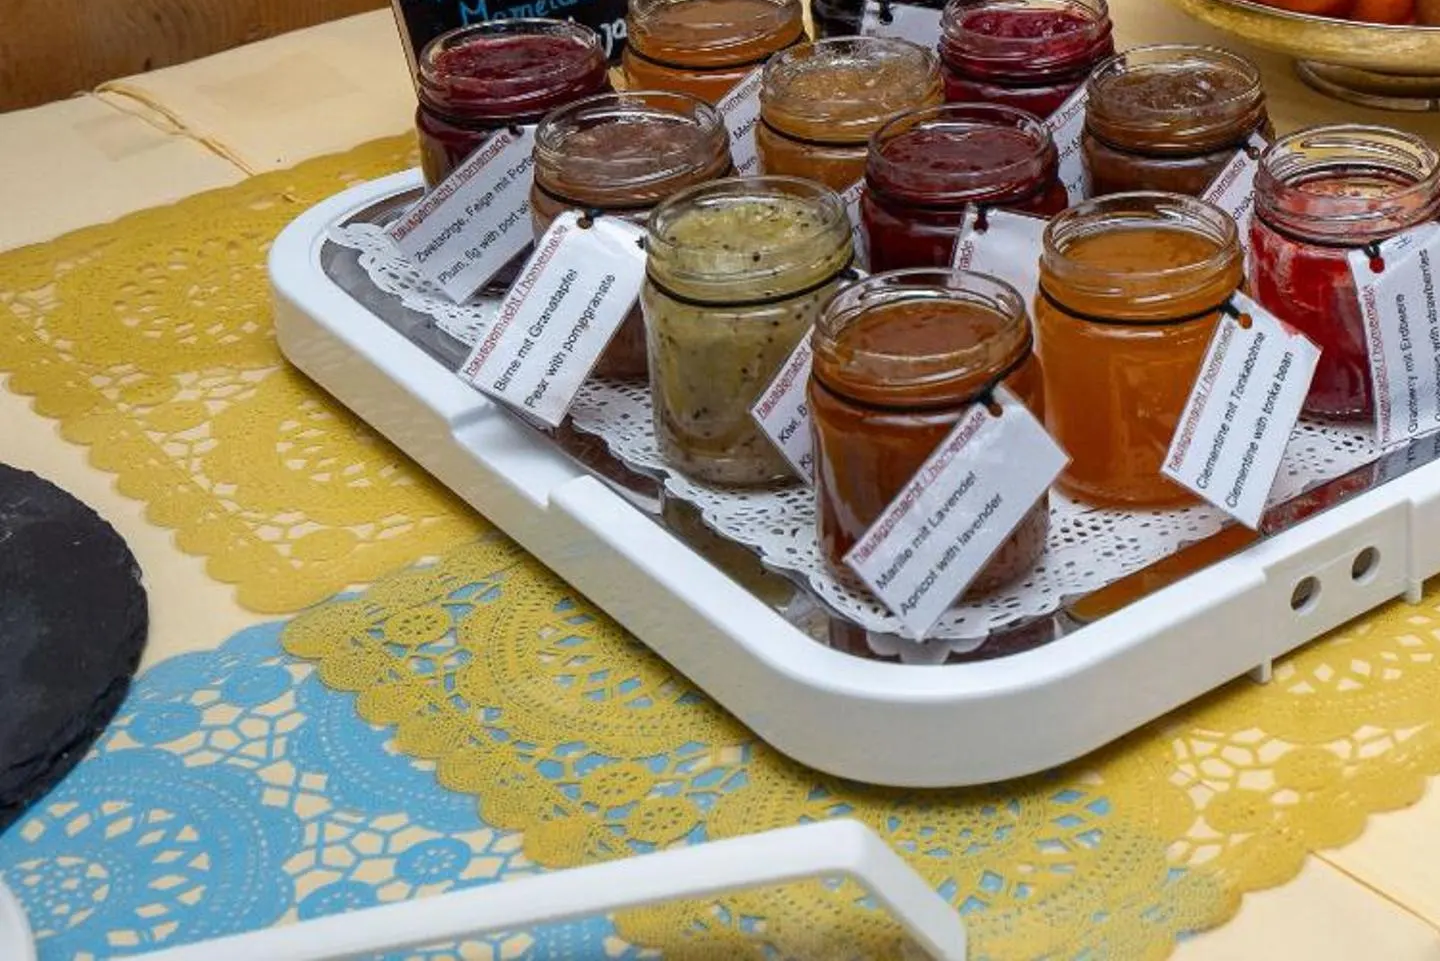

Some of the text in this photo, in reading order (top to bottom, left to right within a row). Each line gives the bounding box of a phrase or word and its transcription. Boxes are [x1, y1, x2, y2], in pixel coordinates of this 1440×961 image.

[463, 243, 482, 262] fig
[476, 225, 500, 250] with
[495, 209, 520, 234] port
[464, 188, 496, 219] Feige
[490, 174, 511, 194] mit
[462, 294, 523, 379] hausgemacht
[491, 266, 580, 393] Birne mit Granatapfel
[523, 271, 618, 409] Pear with pomegranate
[1400, 351, 1415, 372] mit
[1193, 329, 1267, 490] Clementine mit Tonkabohne
[1223, 349, 1294, 509] Clementine with tonka bean
[850, 479, 926, 566] hausgemacht
[873, 469, 978, 591] Marille mit Lavendel
[896, 490, 1005, 617] Apricot with lavender
